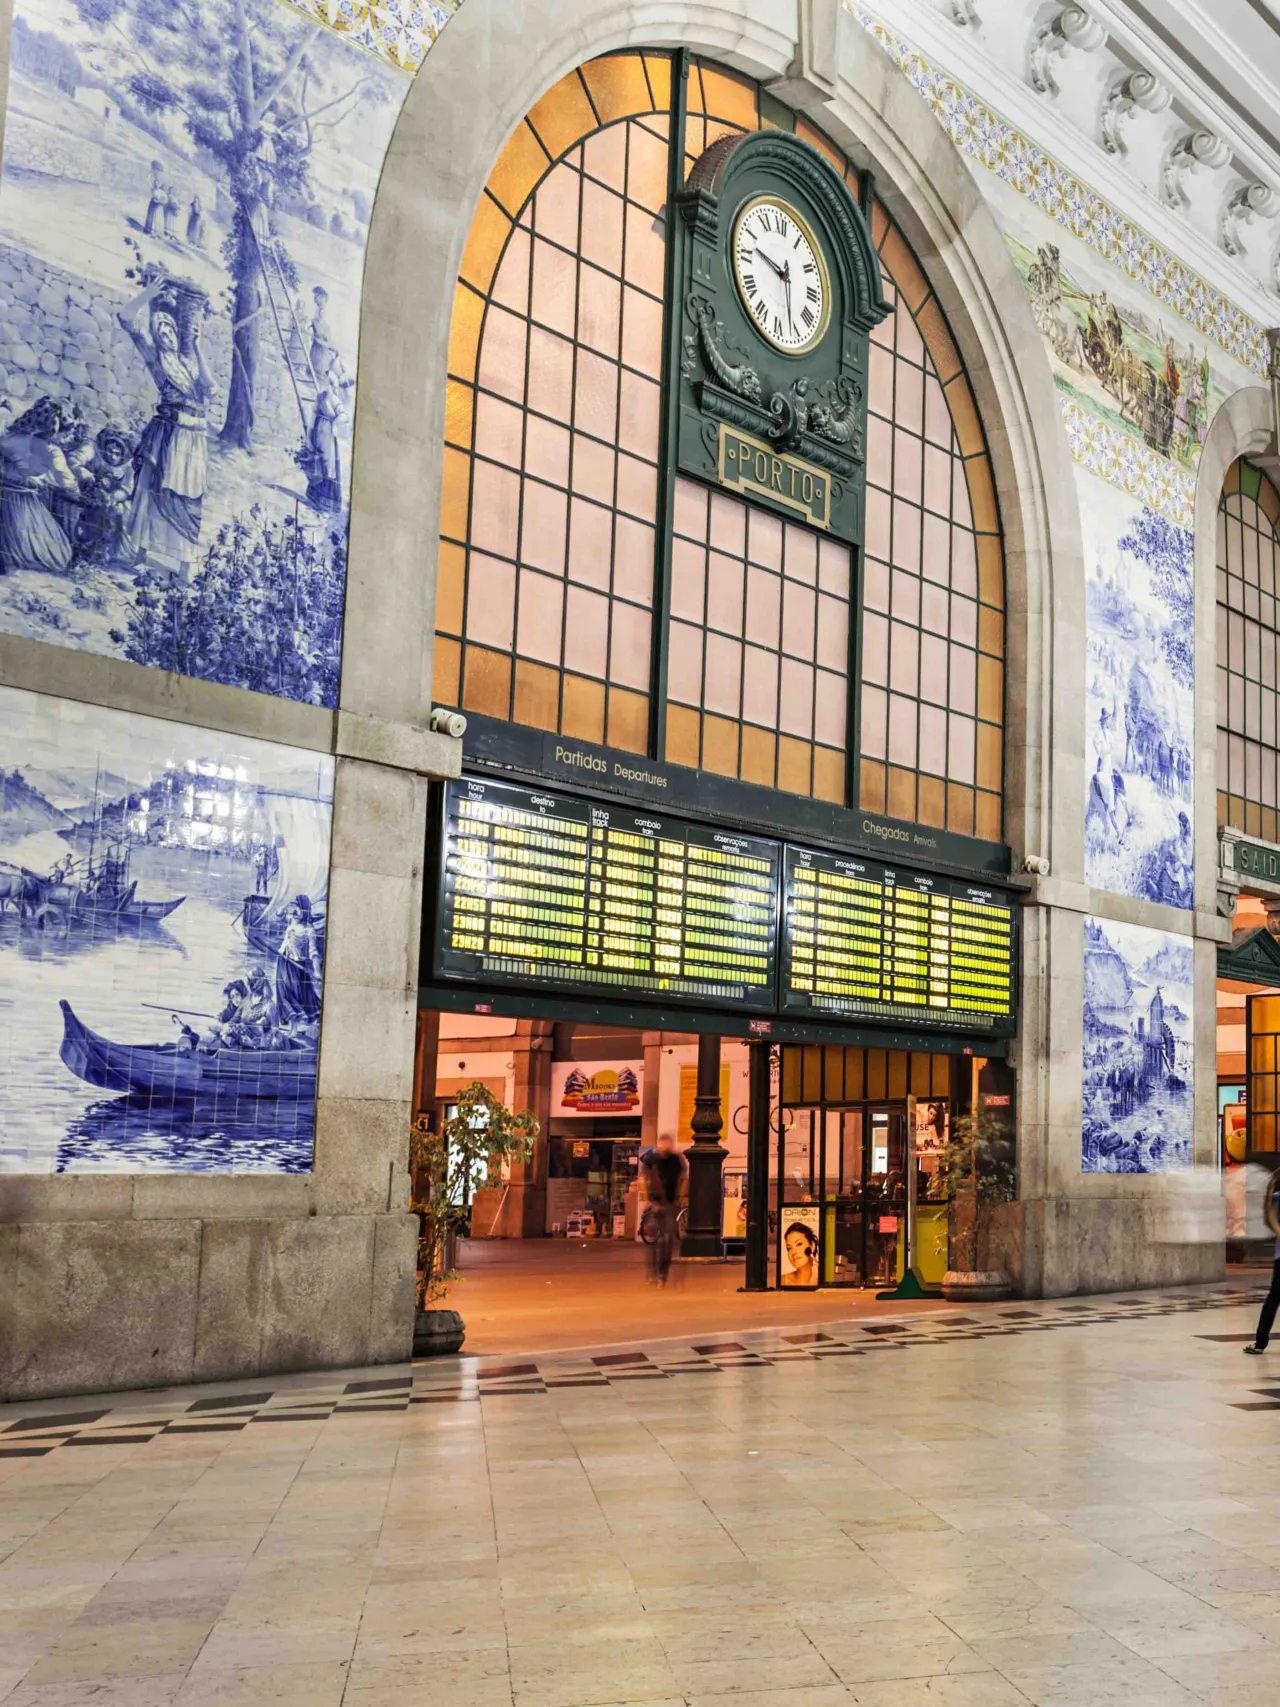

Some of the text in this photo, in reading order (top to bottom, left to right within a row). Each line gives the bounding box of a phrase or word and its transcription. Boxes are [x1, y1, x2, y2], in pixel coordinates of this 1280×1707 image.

[738, 443, 814, 504] PORTO
[555, 746, 668, 788] Partidas Departures
[468, 782, 485, 793] hora
[468, 790, 483, 800] hour
[531, 795, 555, 808] destino
[592, 808, 609, 820] linha
[592, 817, 609, 828] track
[634, 818, 661, 830] comboio
[642, 827, 654, 836] train
[862, 820, 937, 848] Chegadas Arrivals
[607, 829, 639, 848] SUBURB
[713, 833, 748, 848] observações
[800, 851, 811, 860] hora
[884, 869, 896, 878] linha
[914, 876, 933, 887] comboio
[453, 895, 486, 912] 22H55
[451, 934, 484, 950] 23H20
[488, 938, 542, 957] GUIMARAES
[602, 951, 634, 969] SUBURB
[784, 1208, 816, 1216] ORION
